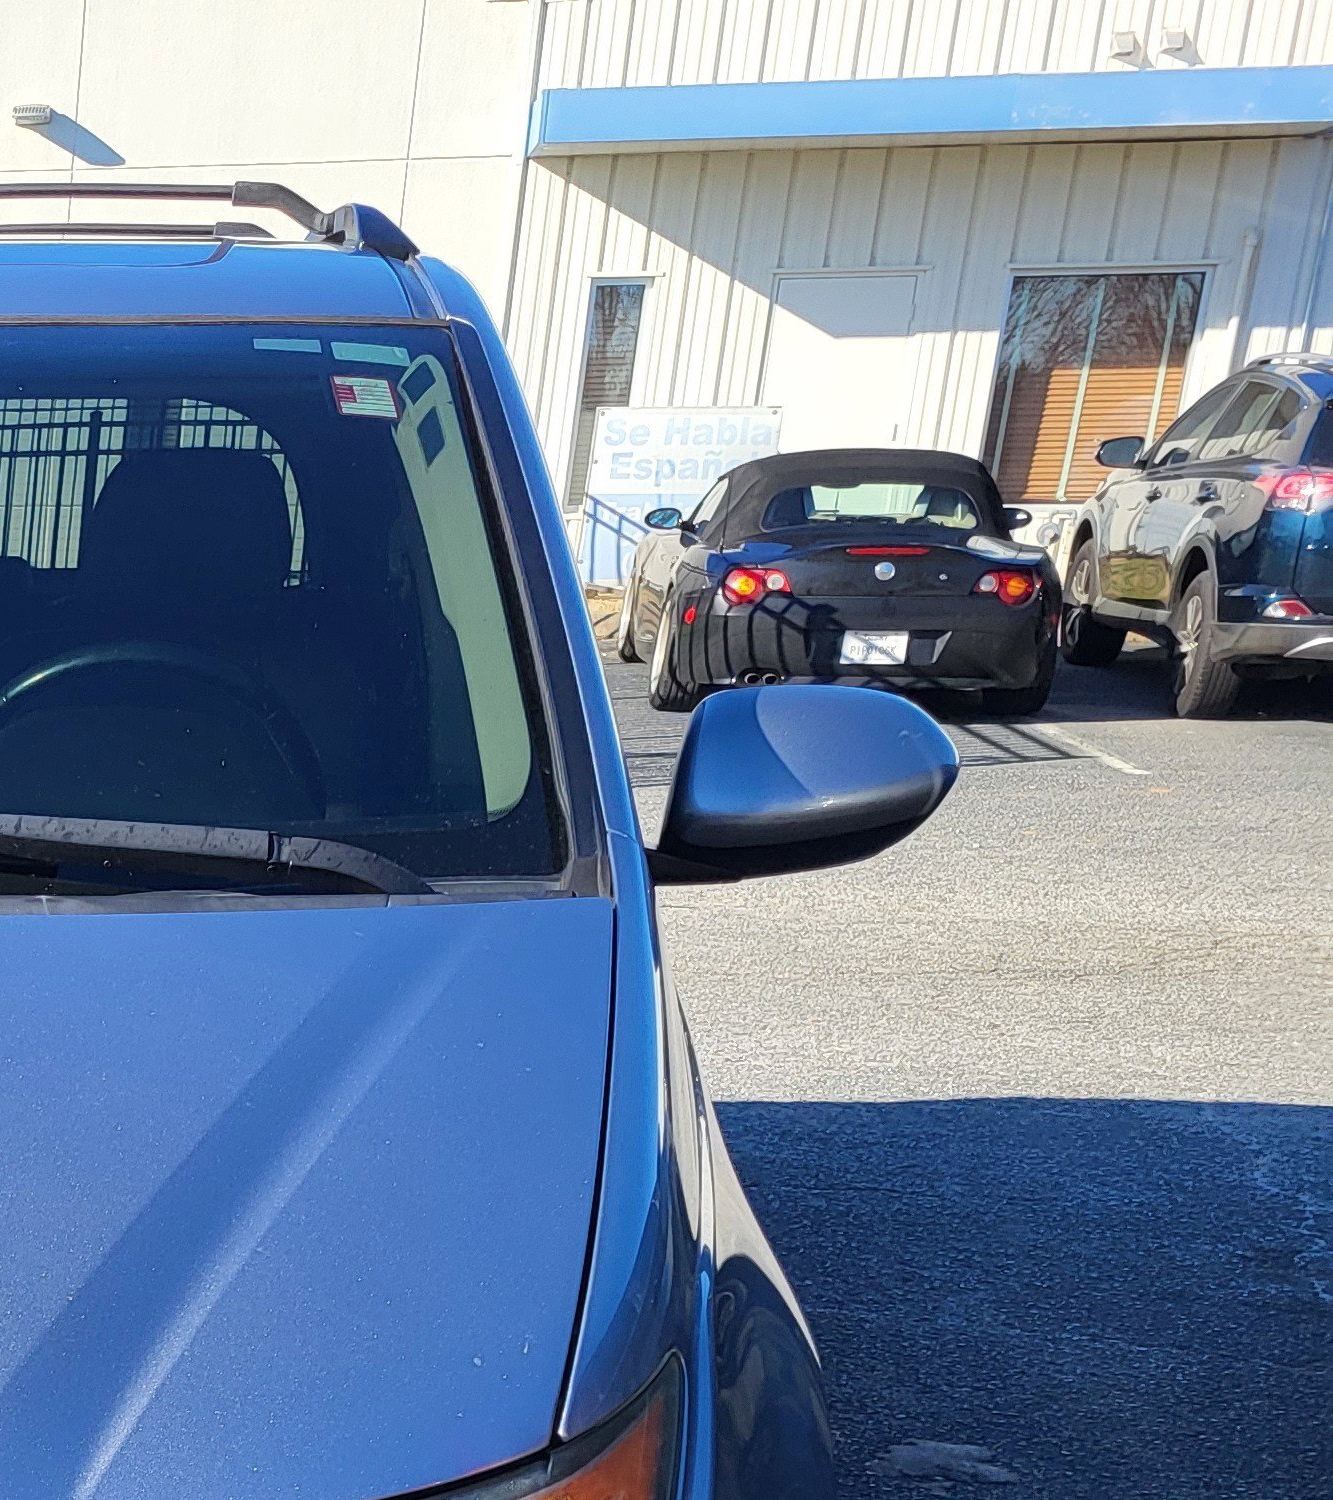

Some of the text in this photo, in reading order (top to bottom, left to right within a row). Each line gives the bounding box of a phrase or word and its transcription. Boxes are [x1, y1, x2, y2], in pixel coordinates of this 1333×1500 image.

[604, 418, 773, 446] Se Habla
[610, 450, 759, 487] Españ
